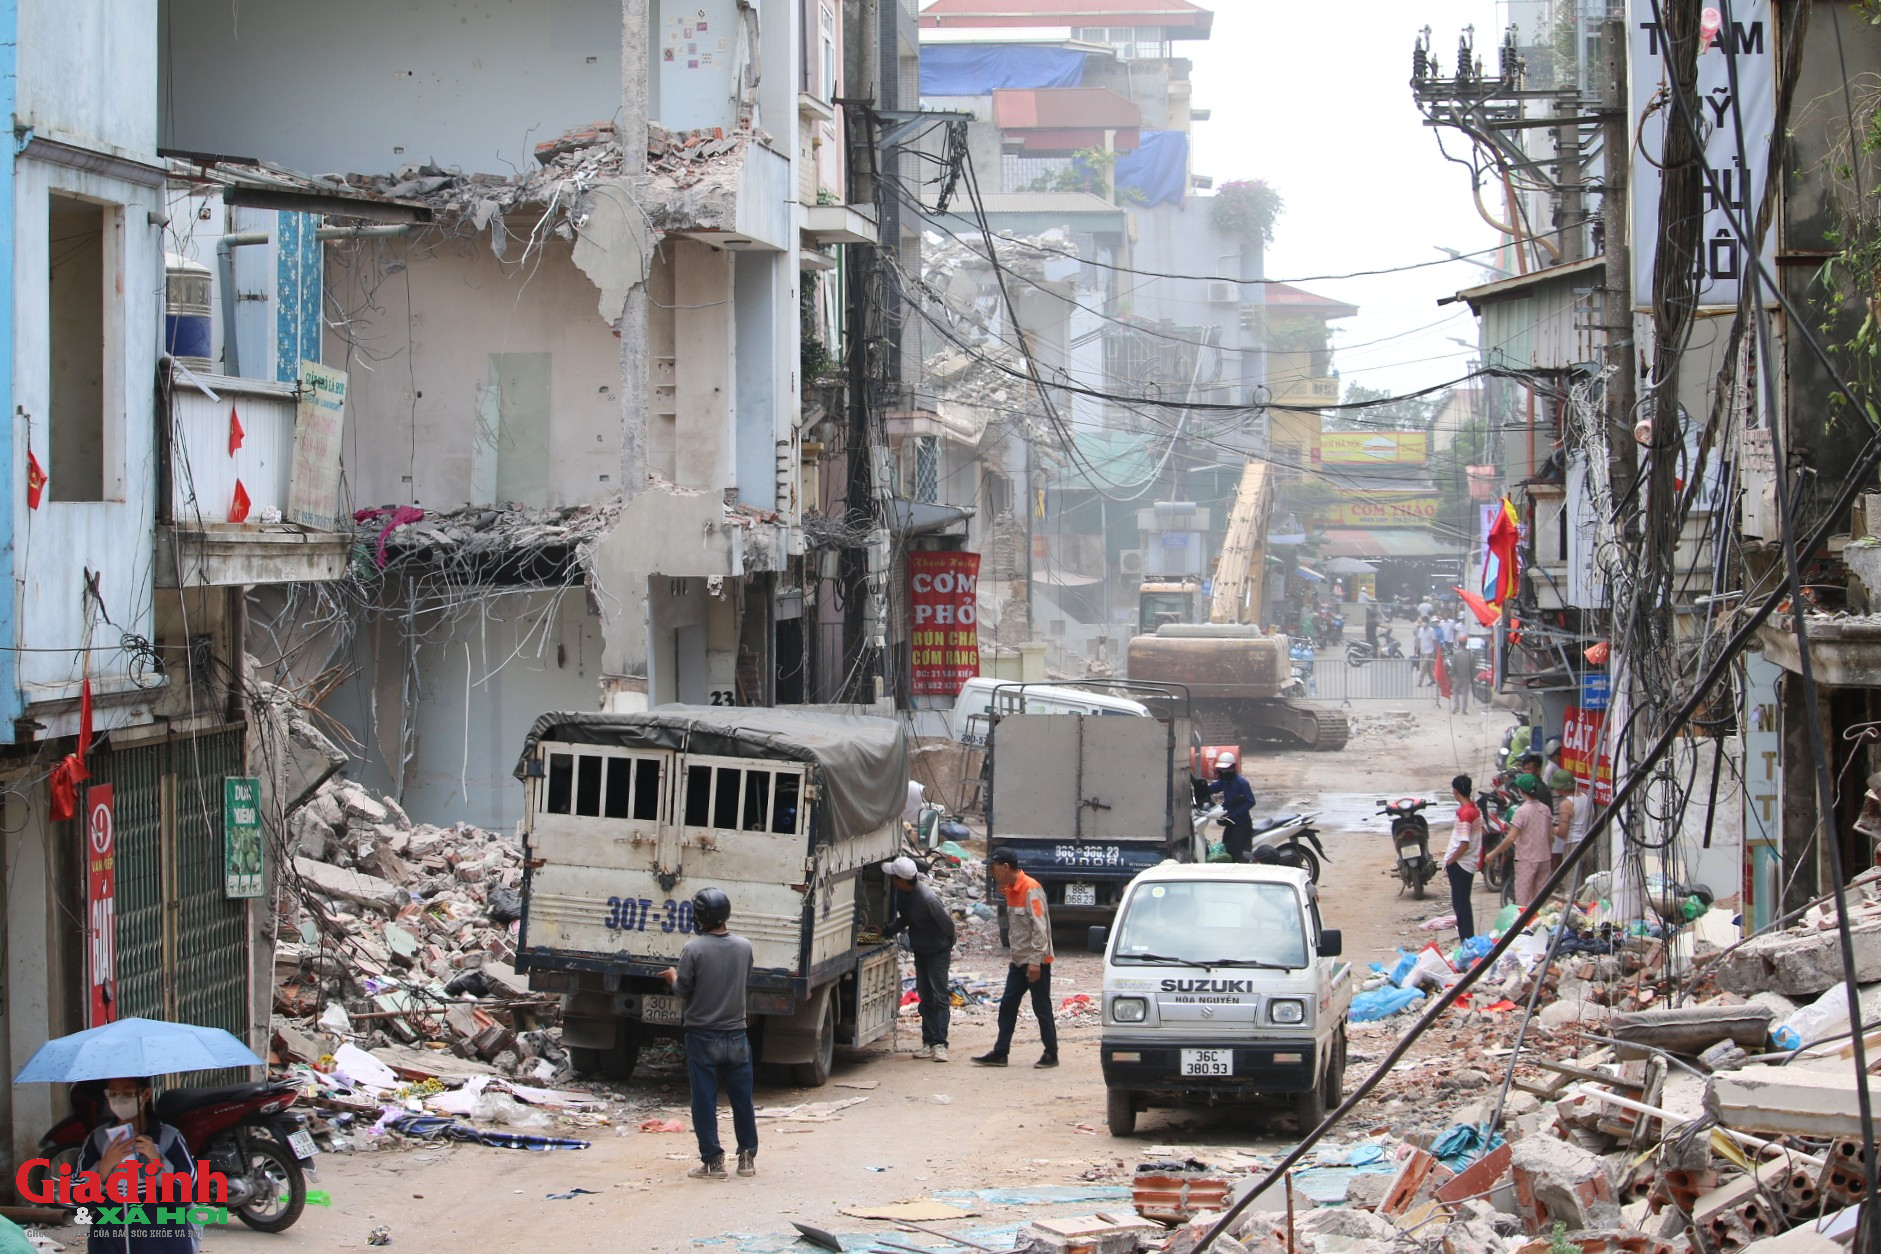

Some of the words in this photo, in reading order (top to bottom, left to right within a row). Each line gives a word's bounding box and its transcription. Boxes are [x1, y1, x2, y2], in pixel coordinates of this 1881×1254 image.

[912, 569, 976, 593] CƠM
[914, 596, 977, 625] PHỞ
[913, 628, 944, 646] BÚN
[949, 627, 977, 647] CHẢ
[912, 648, 942, 665] CƠM
[946, 650, 977, 666] RANG
[931, 669, 940, 678] 31
[710, 690, 735, 707] 23
[1563, 712, 1594, 753] CẮT
[1072, 885, 1089, 895] 88C
[604, 896, 706, 936] 30T-30
[1160, 978, 1253, 993] SUZUKI
[1196, 1050, 1219, 1062] 36C
[1186, 1063, 1228, 1075] 380.93
